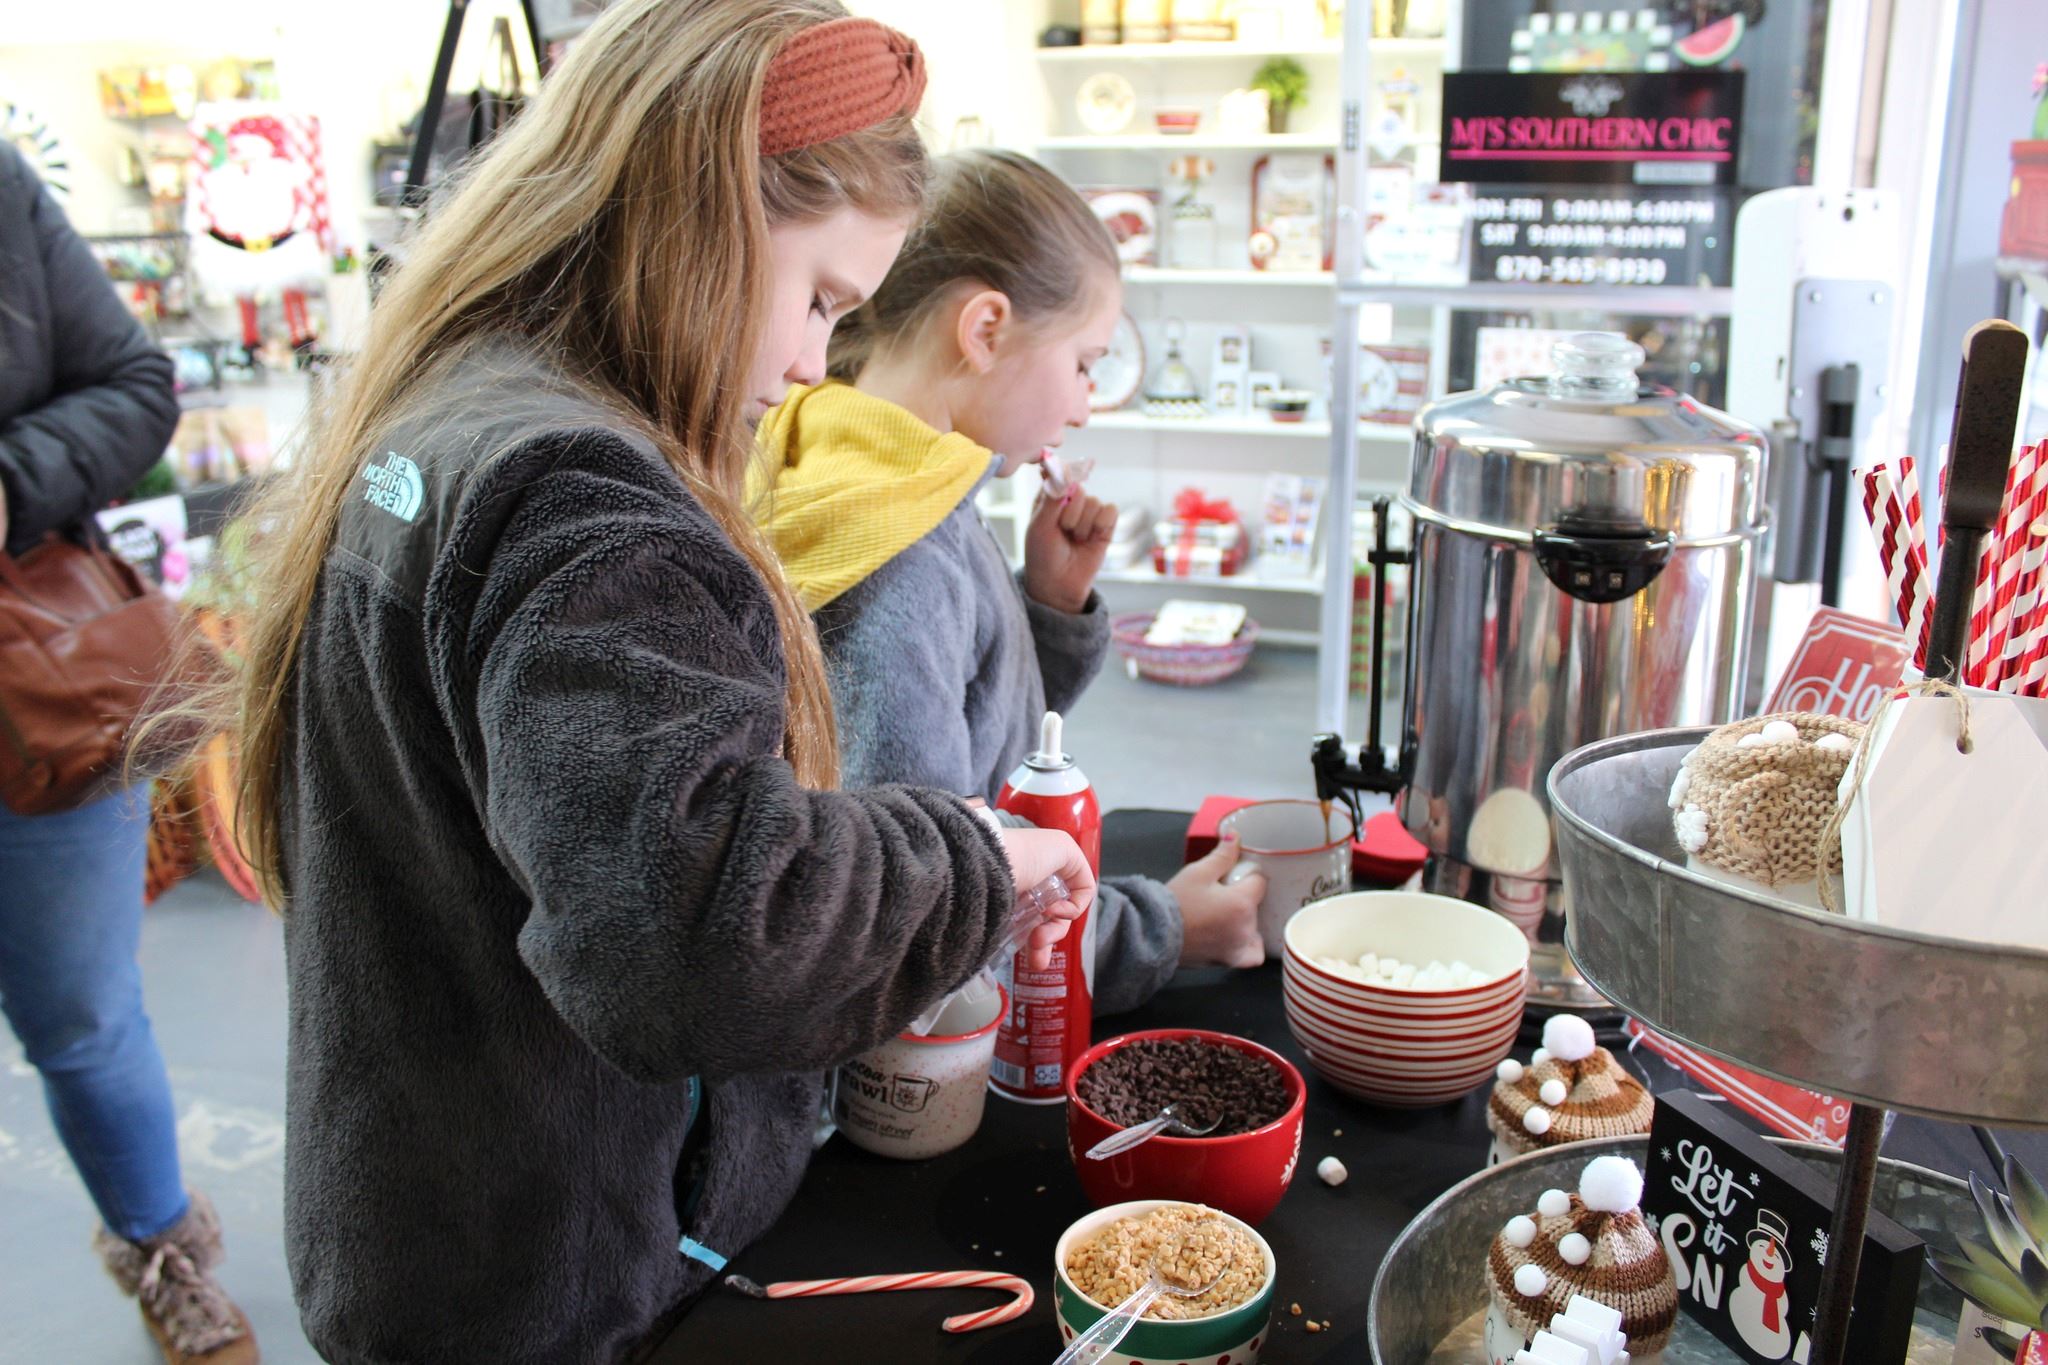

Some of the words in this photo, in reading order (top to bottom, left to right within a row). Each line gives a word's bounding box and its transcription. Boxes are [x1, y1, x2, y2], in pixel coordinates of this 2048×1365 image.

[1508, 117, 1655, 148] SOUTHERN
[1659, 117, 1731, 149] CHIC
[1480, 223, 1518, 246] SAT
[362, 462, 402, 495] NORTH
[385, 451, 408, 478] THE
[364, 484, 397, 513] FACE
[1781, 656, 1888, 724] Ho
[1671, 1139, 1754, 1218] Let
[1704, 1220, 1738, 1255] it
